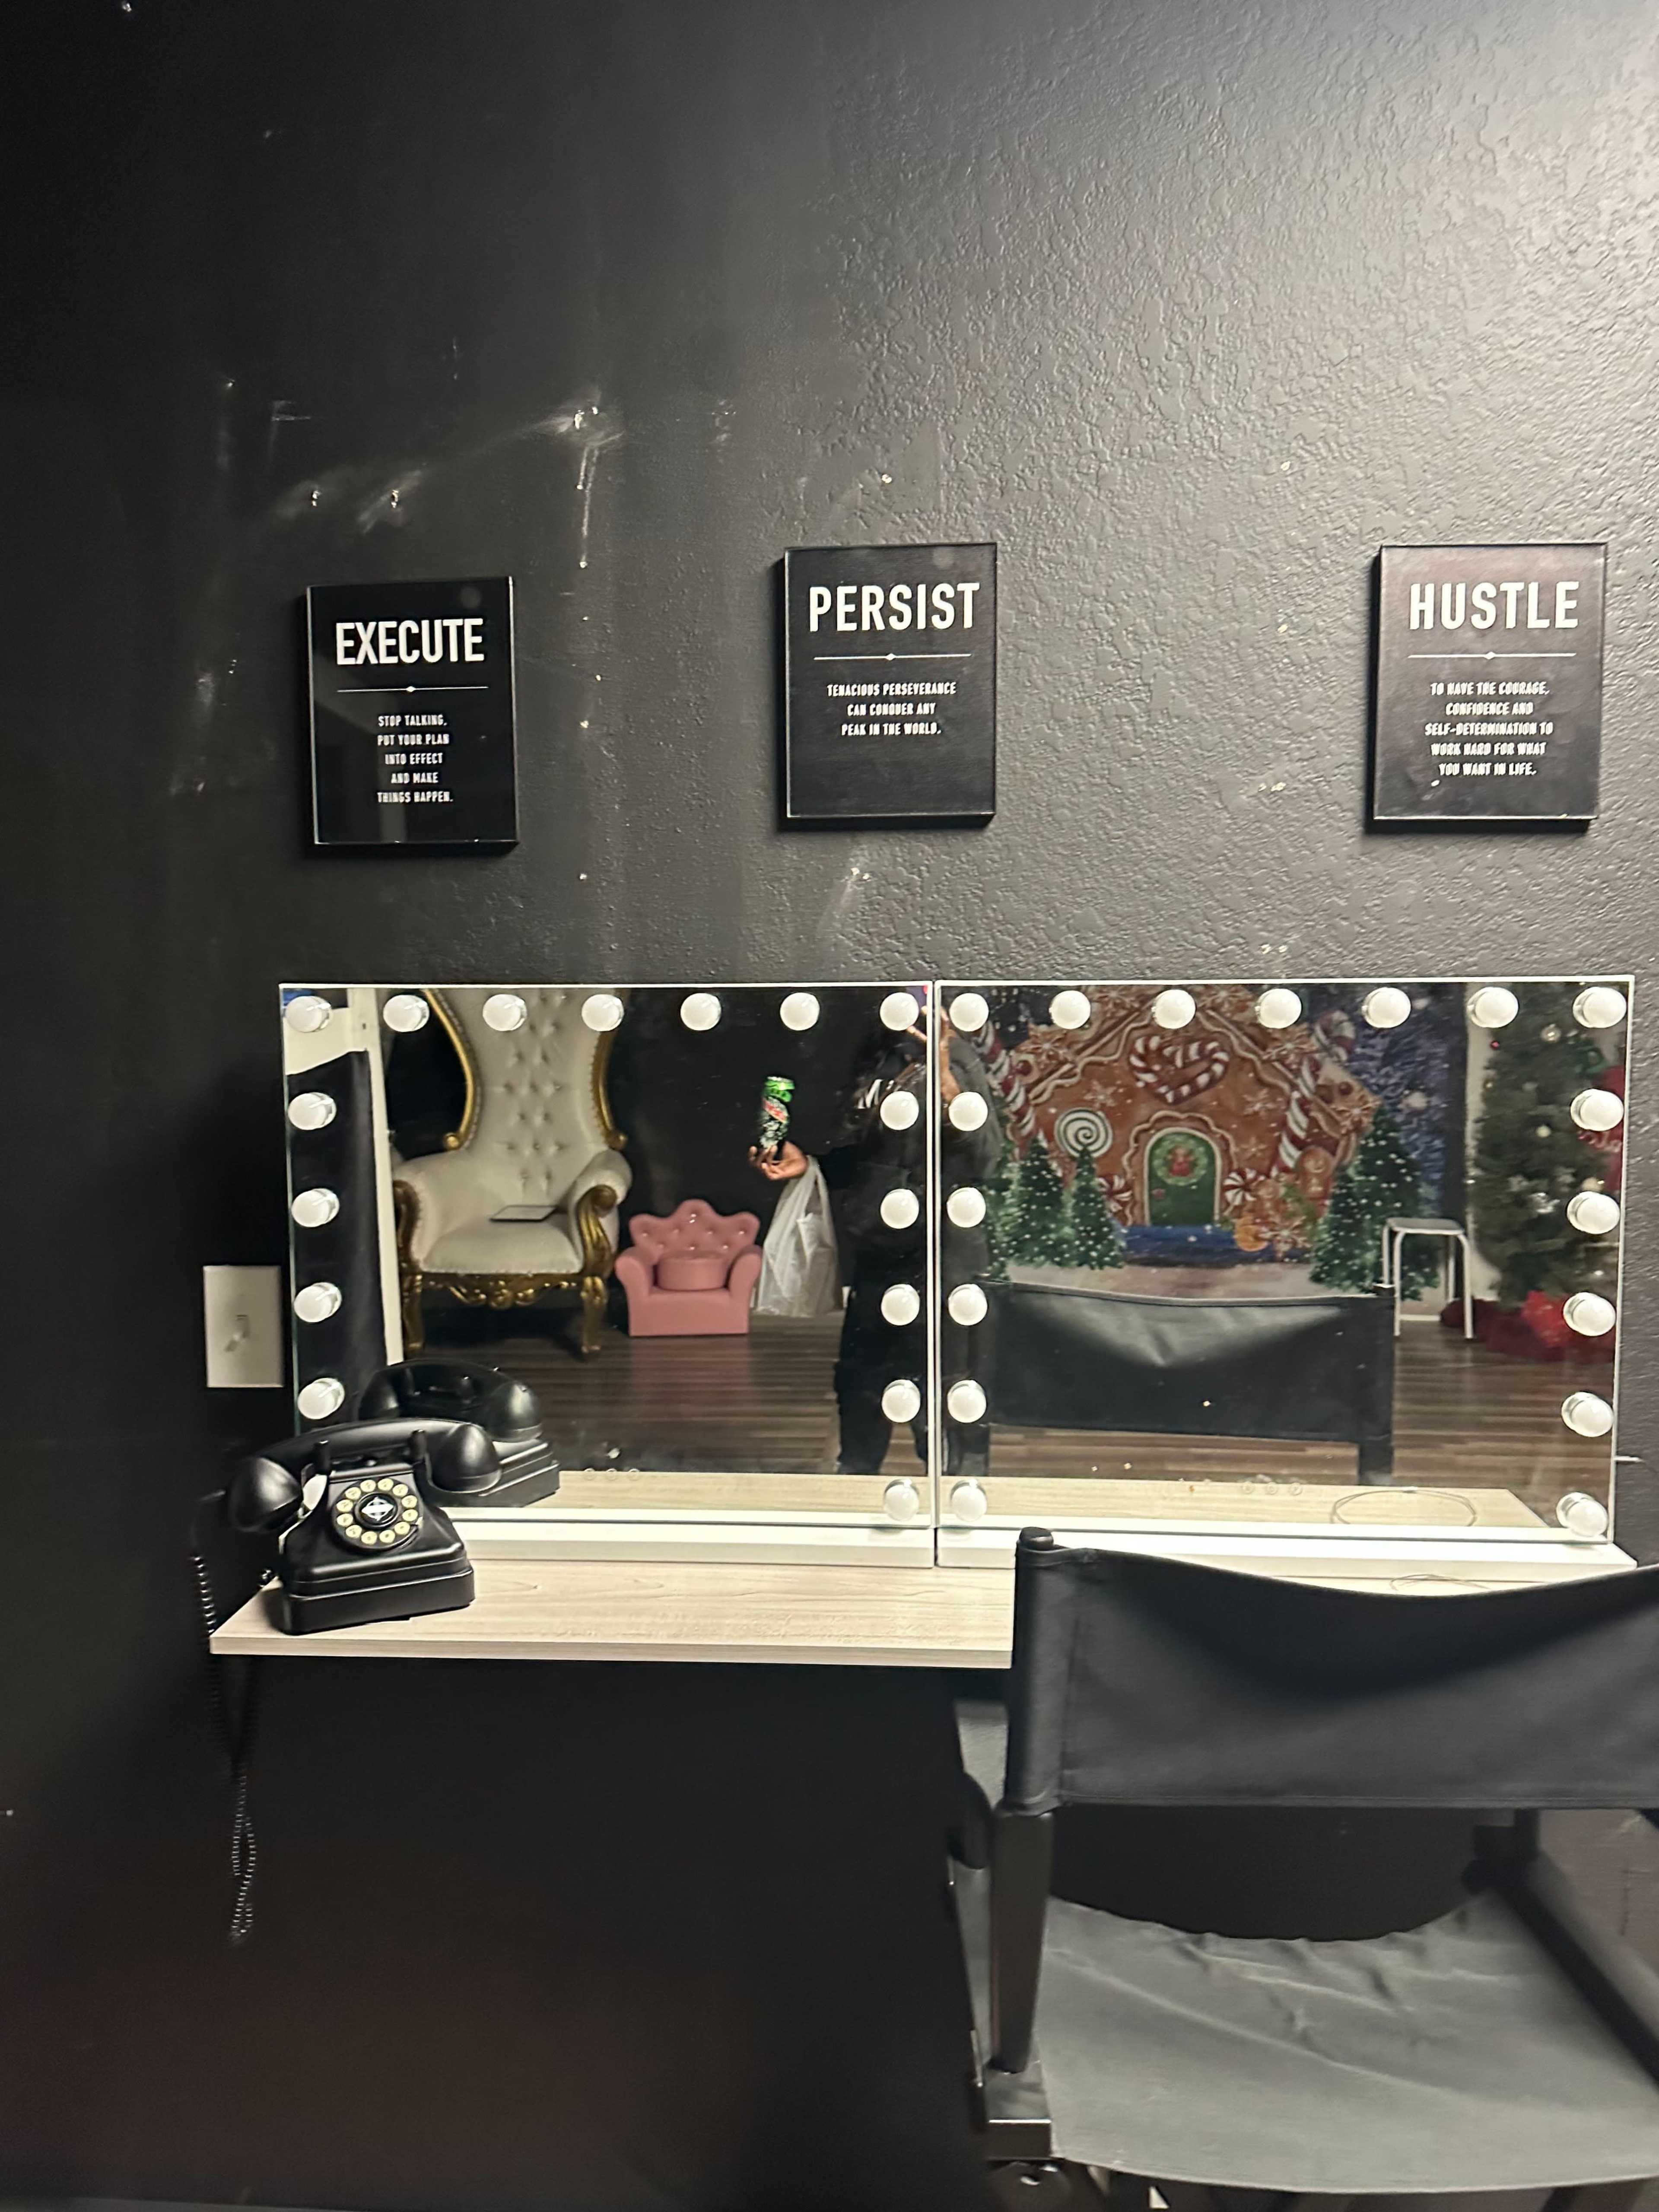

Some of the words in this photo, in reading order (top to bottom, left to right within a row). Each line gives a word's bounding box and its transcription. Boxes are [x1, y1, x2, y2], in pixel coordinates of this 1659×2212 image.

[809, 582, 980, 632] PERSIST
[1409, 582, 1579, 629] HUSTLE
[335, 618, 484, 665] EXECUTE
[827, 684, 880, 697] TENACIOUS
[883, 682, 956, 696] PERSEVERANCE
[1430, 683, 1444, 695] TO
[1446, 682, 1474, 695] HAVE
[1476, 682, 1497, 695] THE
[847, 704, 866, 716] CAN
[869, 703, 914, 715] CONQUER
[916, 702, 936, 715] ANY
[1446, 702, 1510, 715] CONFIDENCE
[1512, 702, 1533, 715] AND
[378, 716, 401, 727] STOP
[841, 723, 866, 736] PEAK
[869, 723, 880, 735] IN
[883, 722, 901, 735] THE
[1424, 722, 1538, 735] SELF-DETERMINATION
[1539, 722, 1554, 734] TO
[377, 734, 394, 746] PUT
[398, 734, 423, 745] YOUR
[425, 734, 449, 745] PLAN
[1430, 742, 1461, 755] WORK
[1463, 742, 1491, 755] HARD
[1493, 743, 1515, 755] FOR
[1517, 742, 1546, 754] WHAT
[385, 753, 407, 765] INTO
[410, 753, 442, 764] EFFECT
[1439, 763, 1459, 775] YOU
[1462, 763, 1491, 775] WANT
[1494, 763, 1506, 775] IN
[391, 773, 409, 784] AND
[413, 772, 438, 783] MAKE
[377, 791, 411, 803] THINGS
